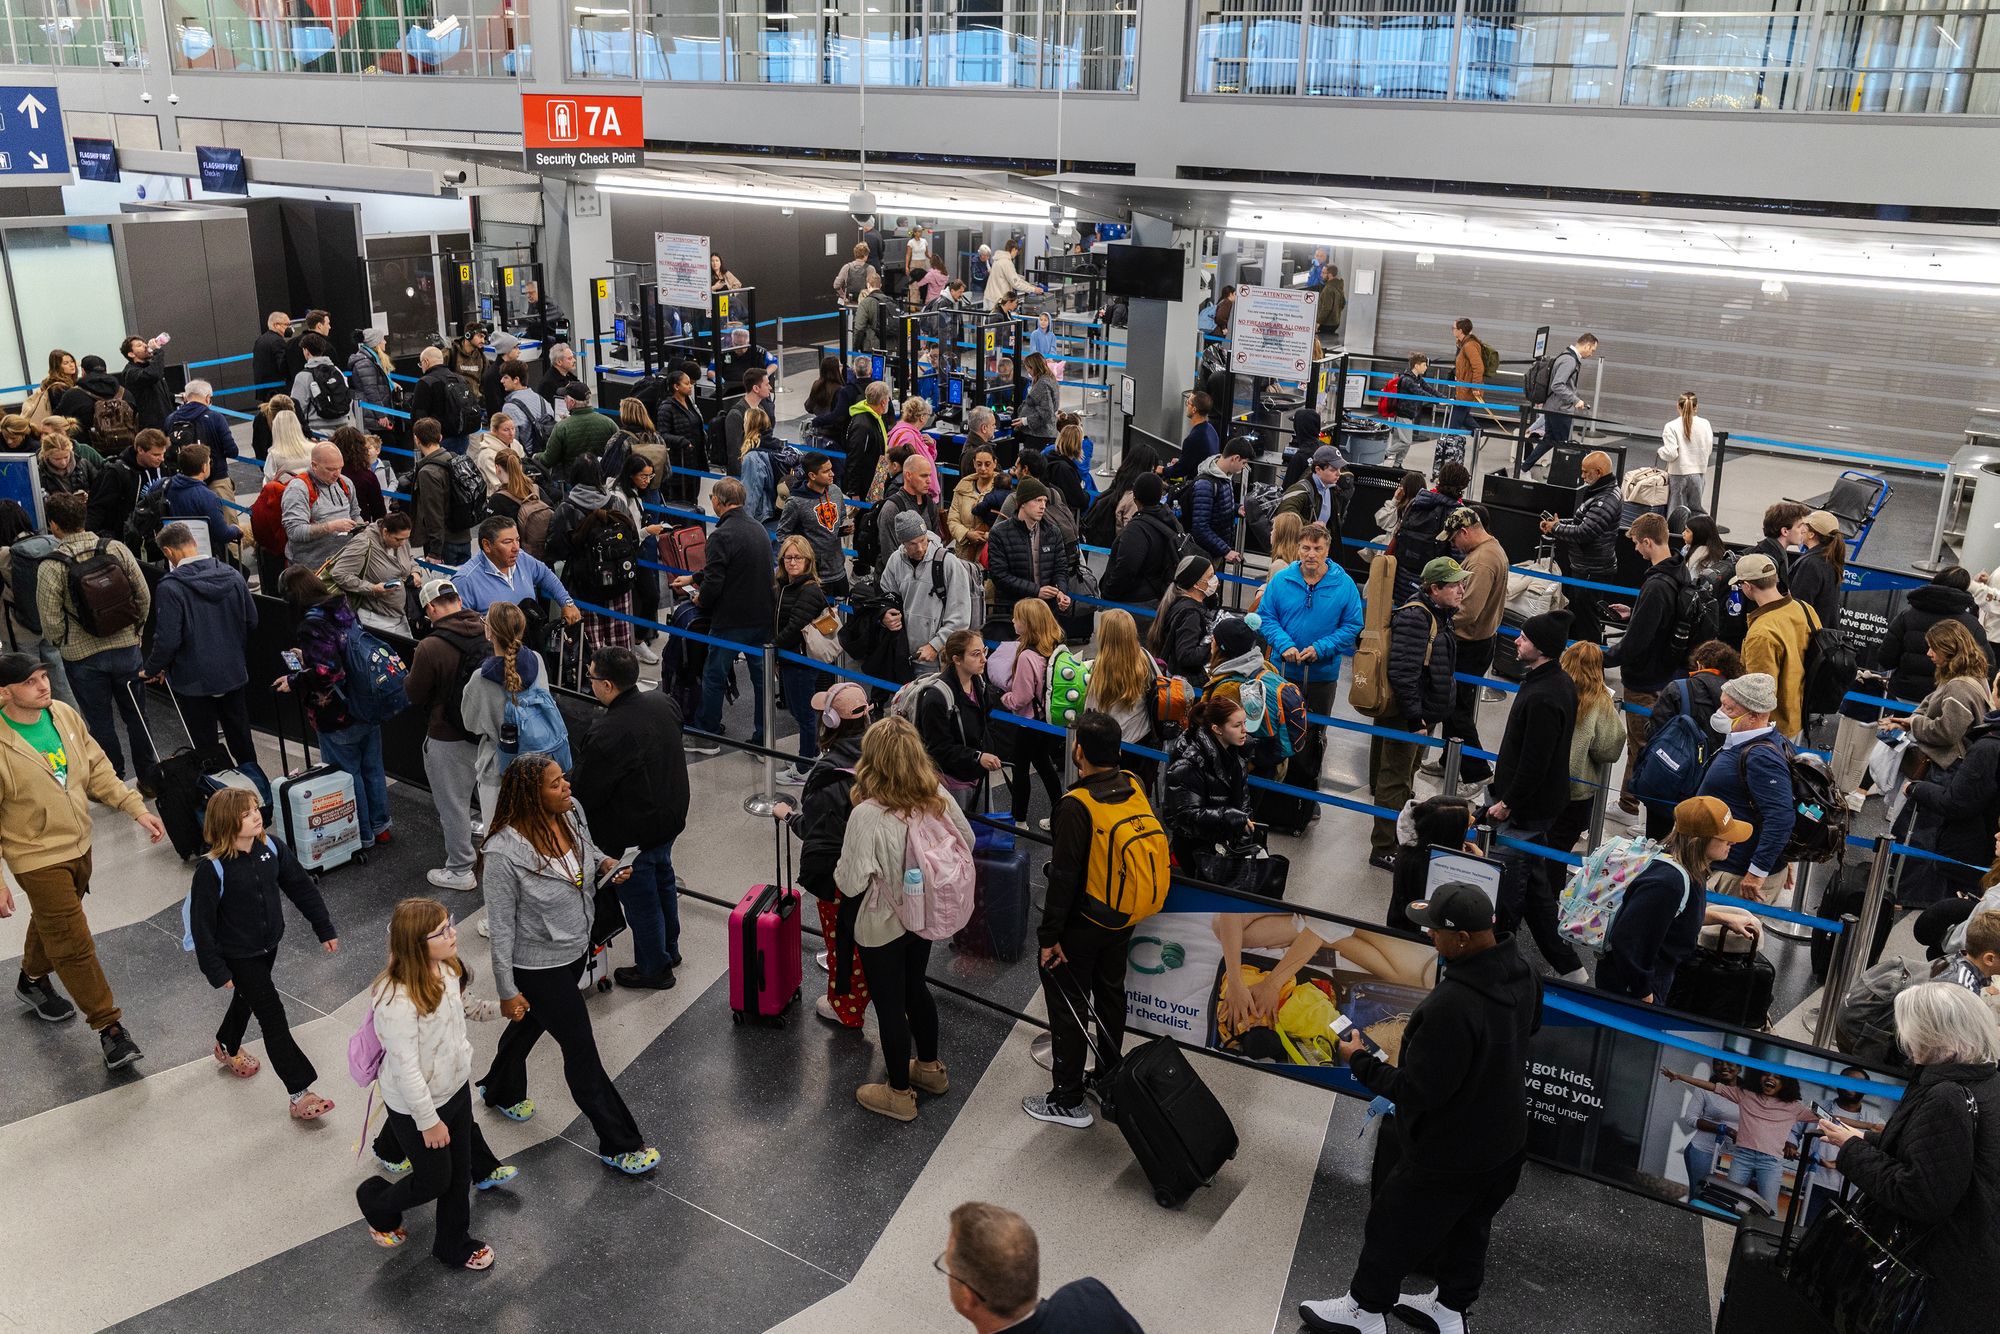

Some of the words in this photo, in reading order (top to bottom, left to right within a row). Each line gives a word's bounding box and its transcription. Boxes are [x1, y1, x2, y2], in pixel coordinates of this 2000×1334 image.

[584, 106, 622, 136] 7A
[80, 151, 99, 160] FLAGSHIP
[536, 153, 576, 166] Security
[580, 152, 609, 164] Check
[612, 152, 636, 164] Point
[203, 162, 225, 170] FLAGSHIP
[225, 163, 238, 171] FIRST
[462, 267, 468, 278] 6
[506, 274, 512, 284] 6
[600, 286, 606, 297] 5
[1262, 291, 1292, 299] ATTENTION
[721, 302, 727, 314] 4
[988, 334, 993, 348] 2
[1843, 569, 1857, 579] Pre
[1854, 611, 1868, 620] got
[1869, 614, 1888, 625] kids,
[1860, 622, 1874, 631] got
[1155, 997, 1167, 1009] to
[1170, 1002, 1199, 1016] your
[1136, 1008, 1192, 1030] checklist.
[1532, 1062, 1557, 1078] got
[1560, 1068, 1594, 1090] kids,
[1544, 1082, 1569, 1098] got
[1572, 1090, 1604, 1109] you.
[1534, 1110, 1556, 1125] free.
[1535, 1100, 1555, 1112] and
[1558, 1107, 1589, 1122] under
